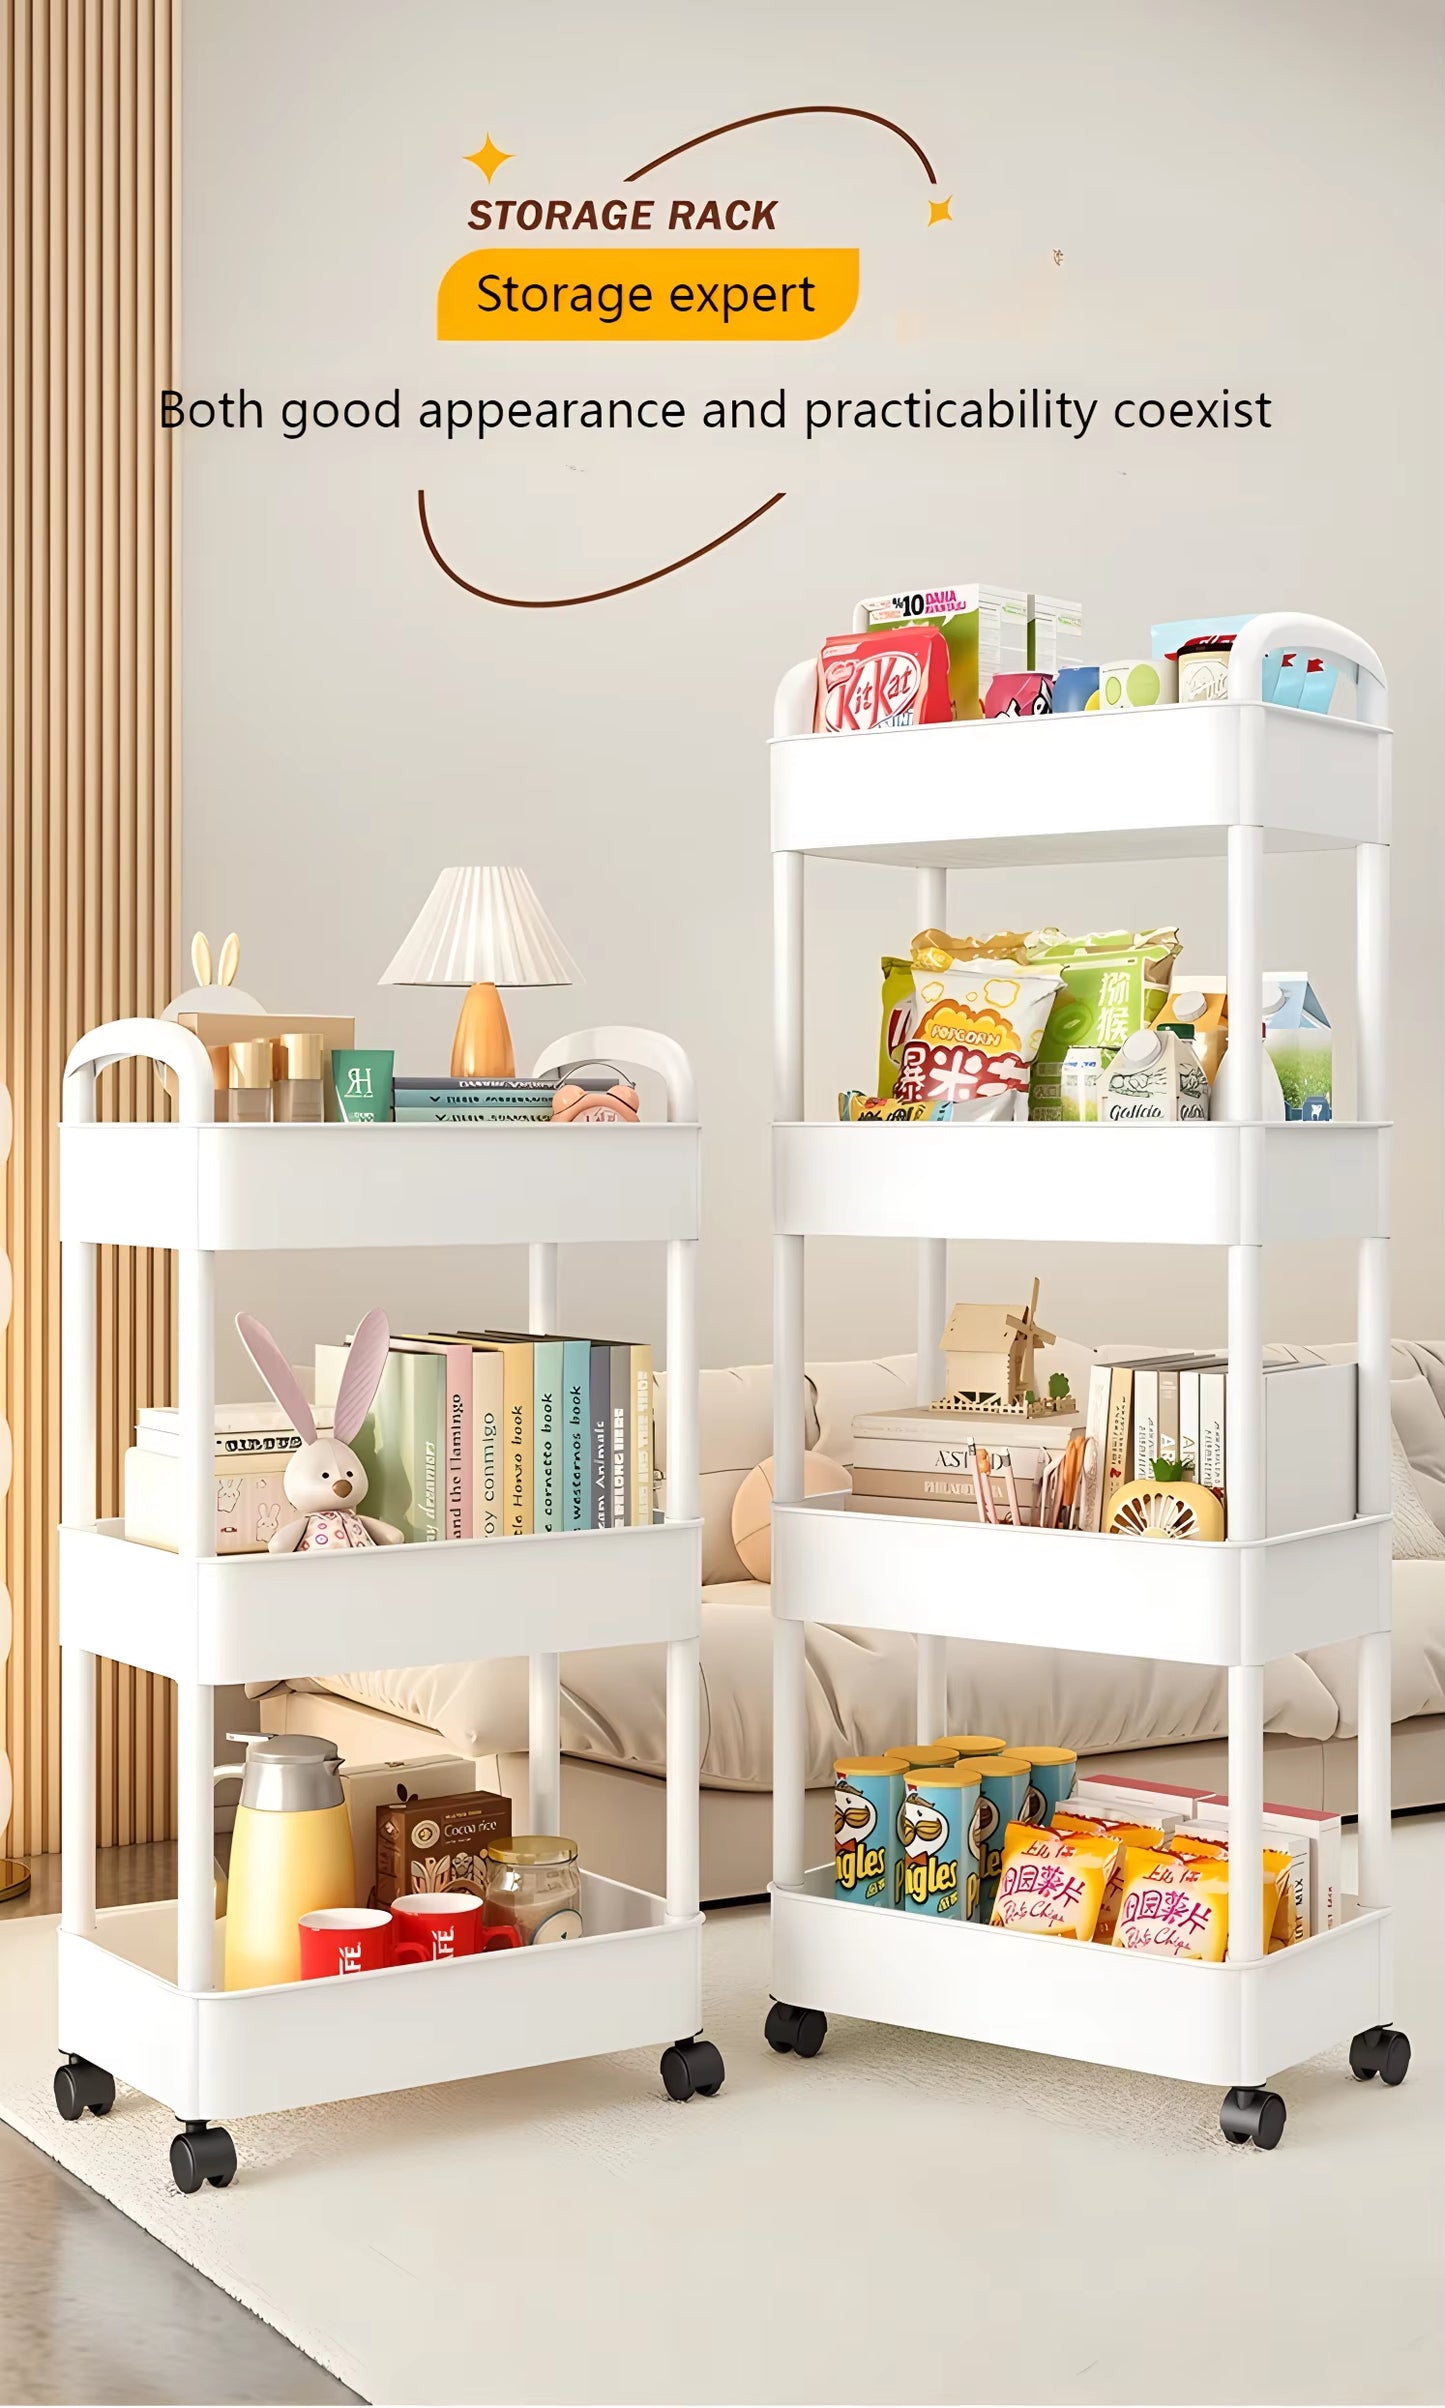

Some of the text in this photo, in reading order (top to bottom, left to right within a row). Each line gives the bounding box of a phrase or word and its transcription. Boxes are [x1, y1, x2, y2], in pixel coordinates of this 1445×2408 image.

[511, 1405, 523, 1445] book
[541, 1393, 553, 1433] book
[570, 1385, 582, 1425] book
[481, 1412, 497, 1502] conmigo
